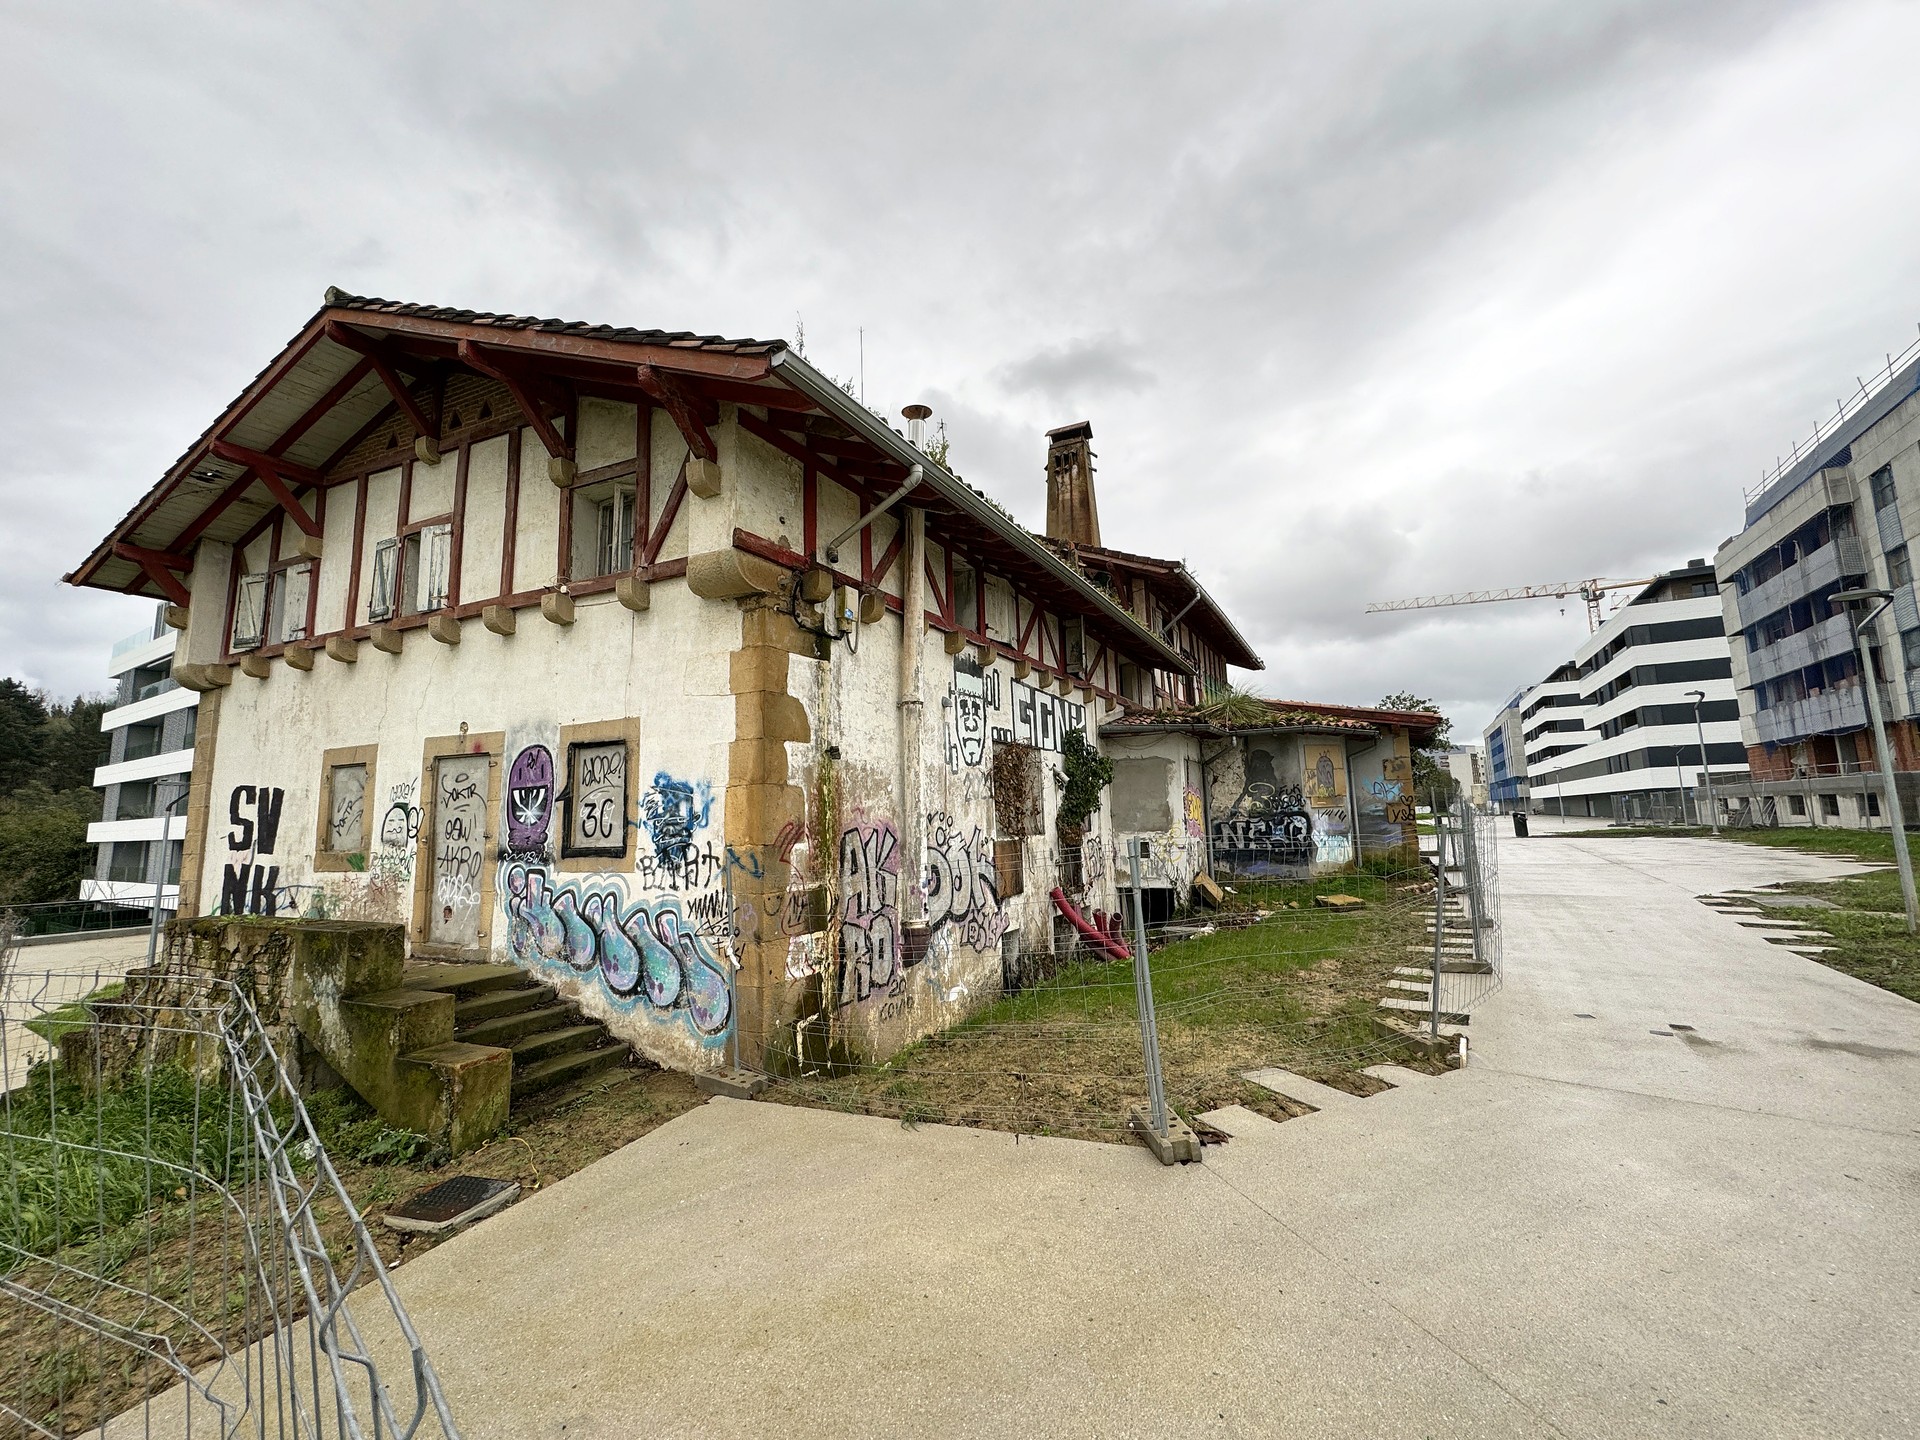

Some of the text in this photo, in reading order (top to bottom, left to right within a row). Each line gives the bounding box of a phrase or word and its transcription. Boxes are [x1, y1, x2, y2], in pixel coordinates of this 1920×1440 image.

[227, 785, 286, 855] SV
[582, 799, 614, 839] 3C
[220, 863, 280, 917] NK
